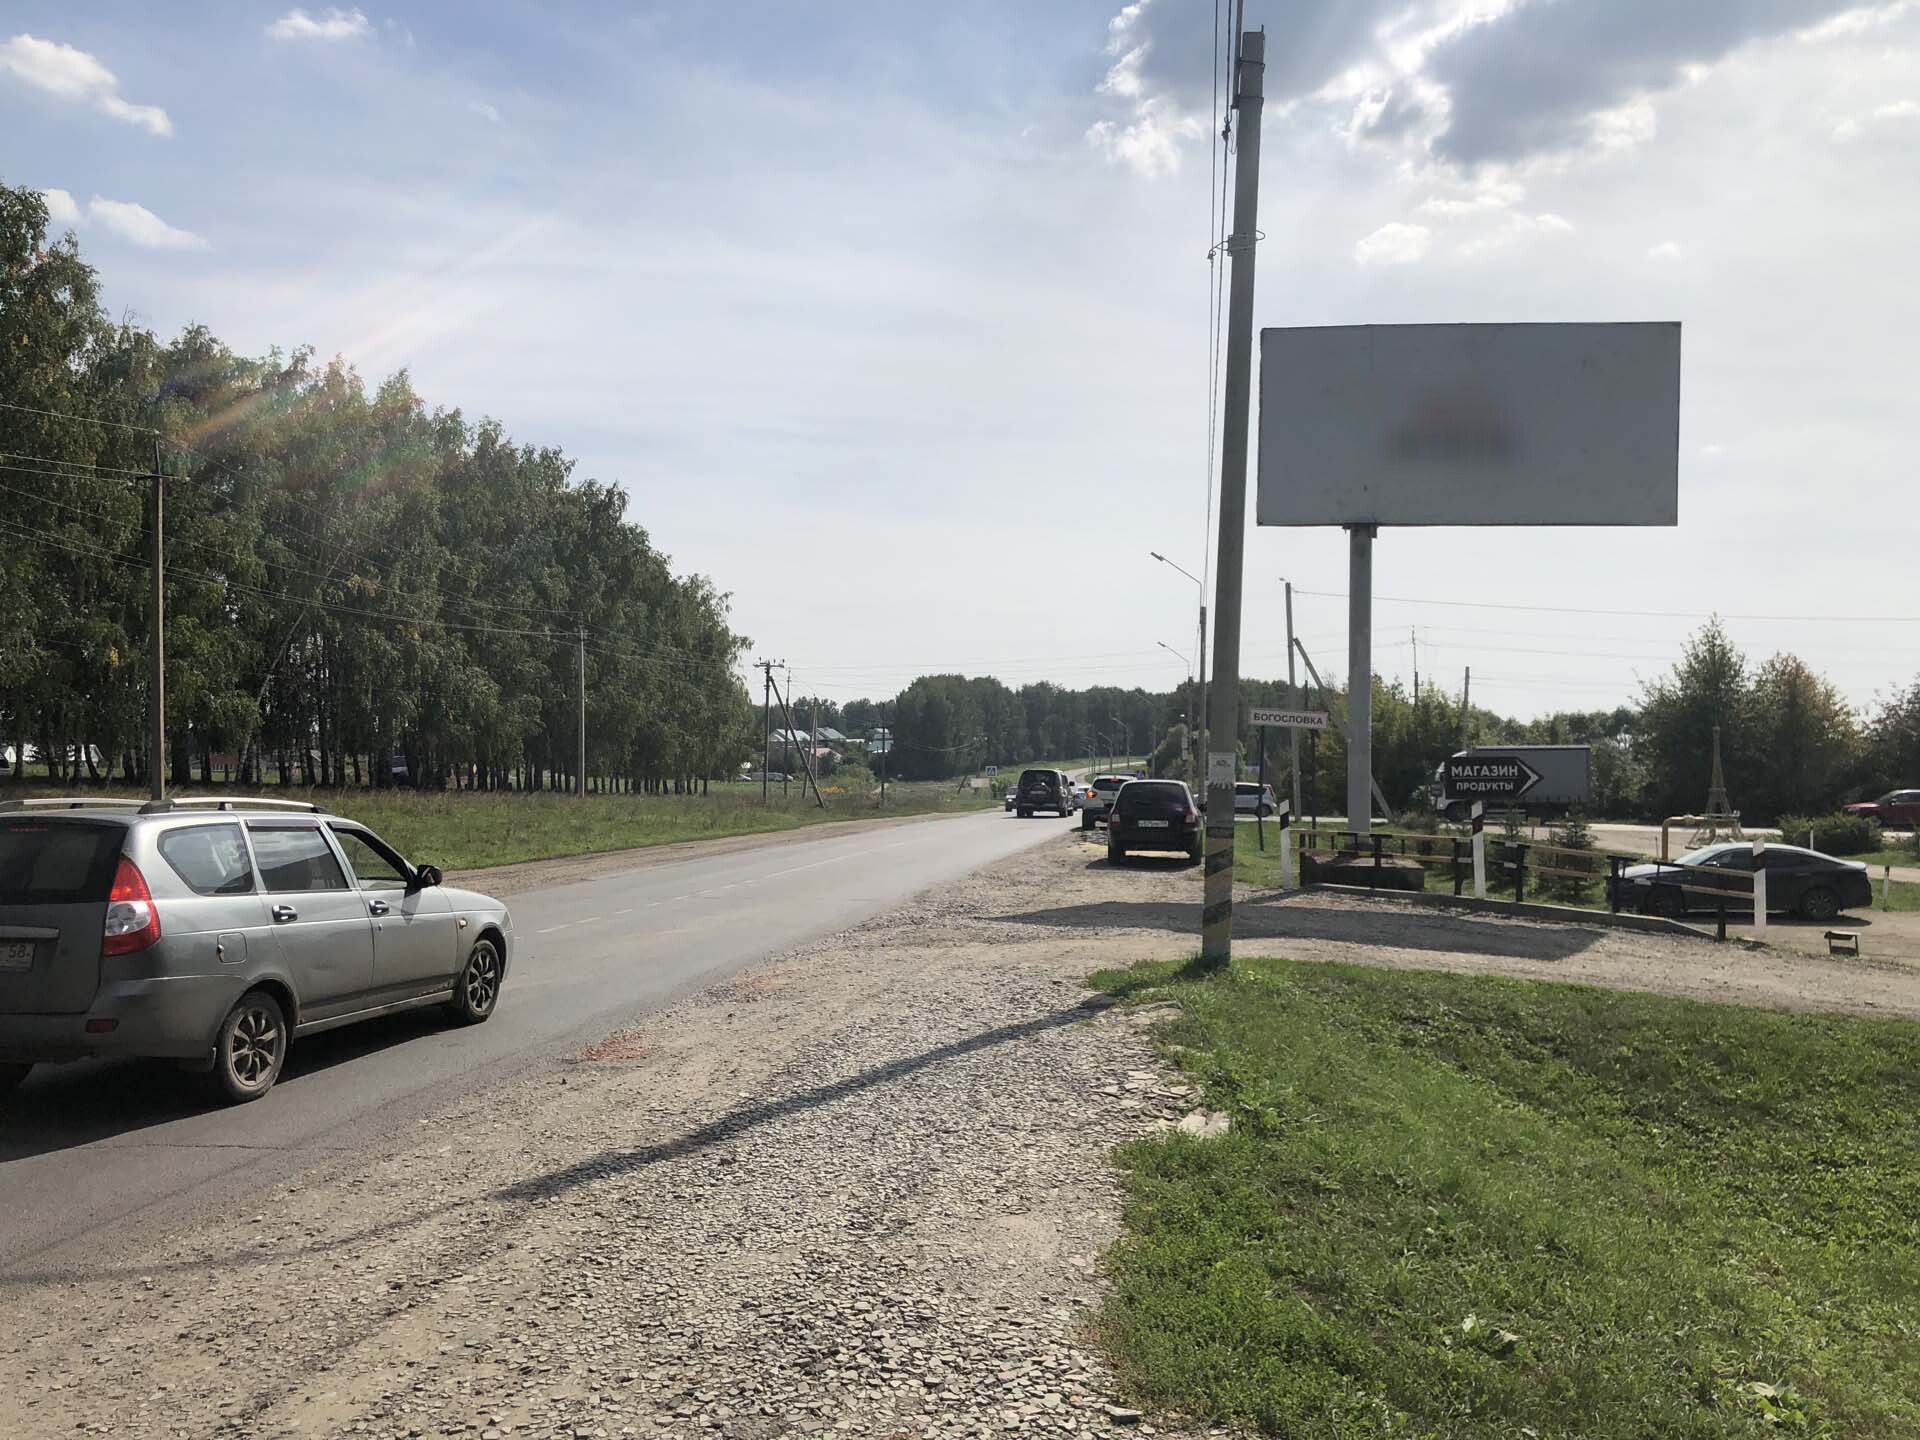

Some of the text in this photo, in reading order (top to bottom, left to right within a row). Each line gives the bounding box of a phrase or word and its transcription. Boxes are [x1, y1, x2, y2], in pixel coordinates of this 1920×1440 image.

[1253, 712, 1323, 725] БОГОСЛОВКА
[1451, 765, 1518, 777] МАГАЗИН
[1456, 781, 1514, 792] ПРОДУКТЫ
